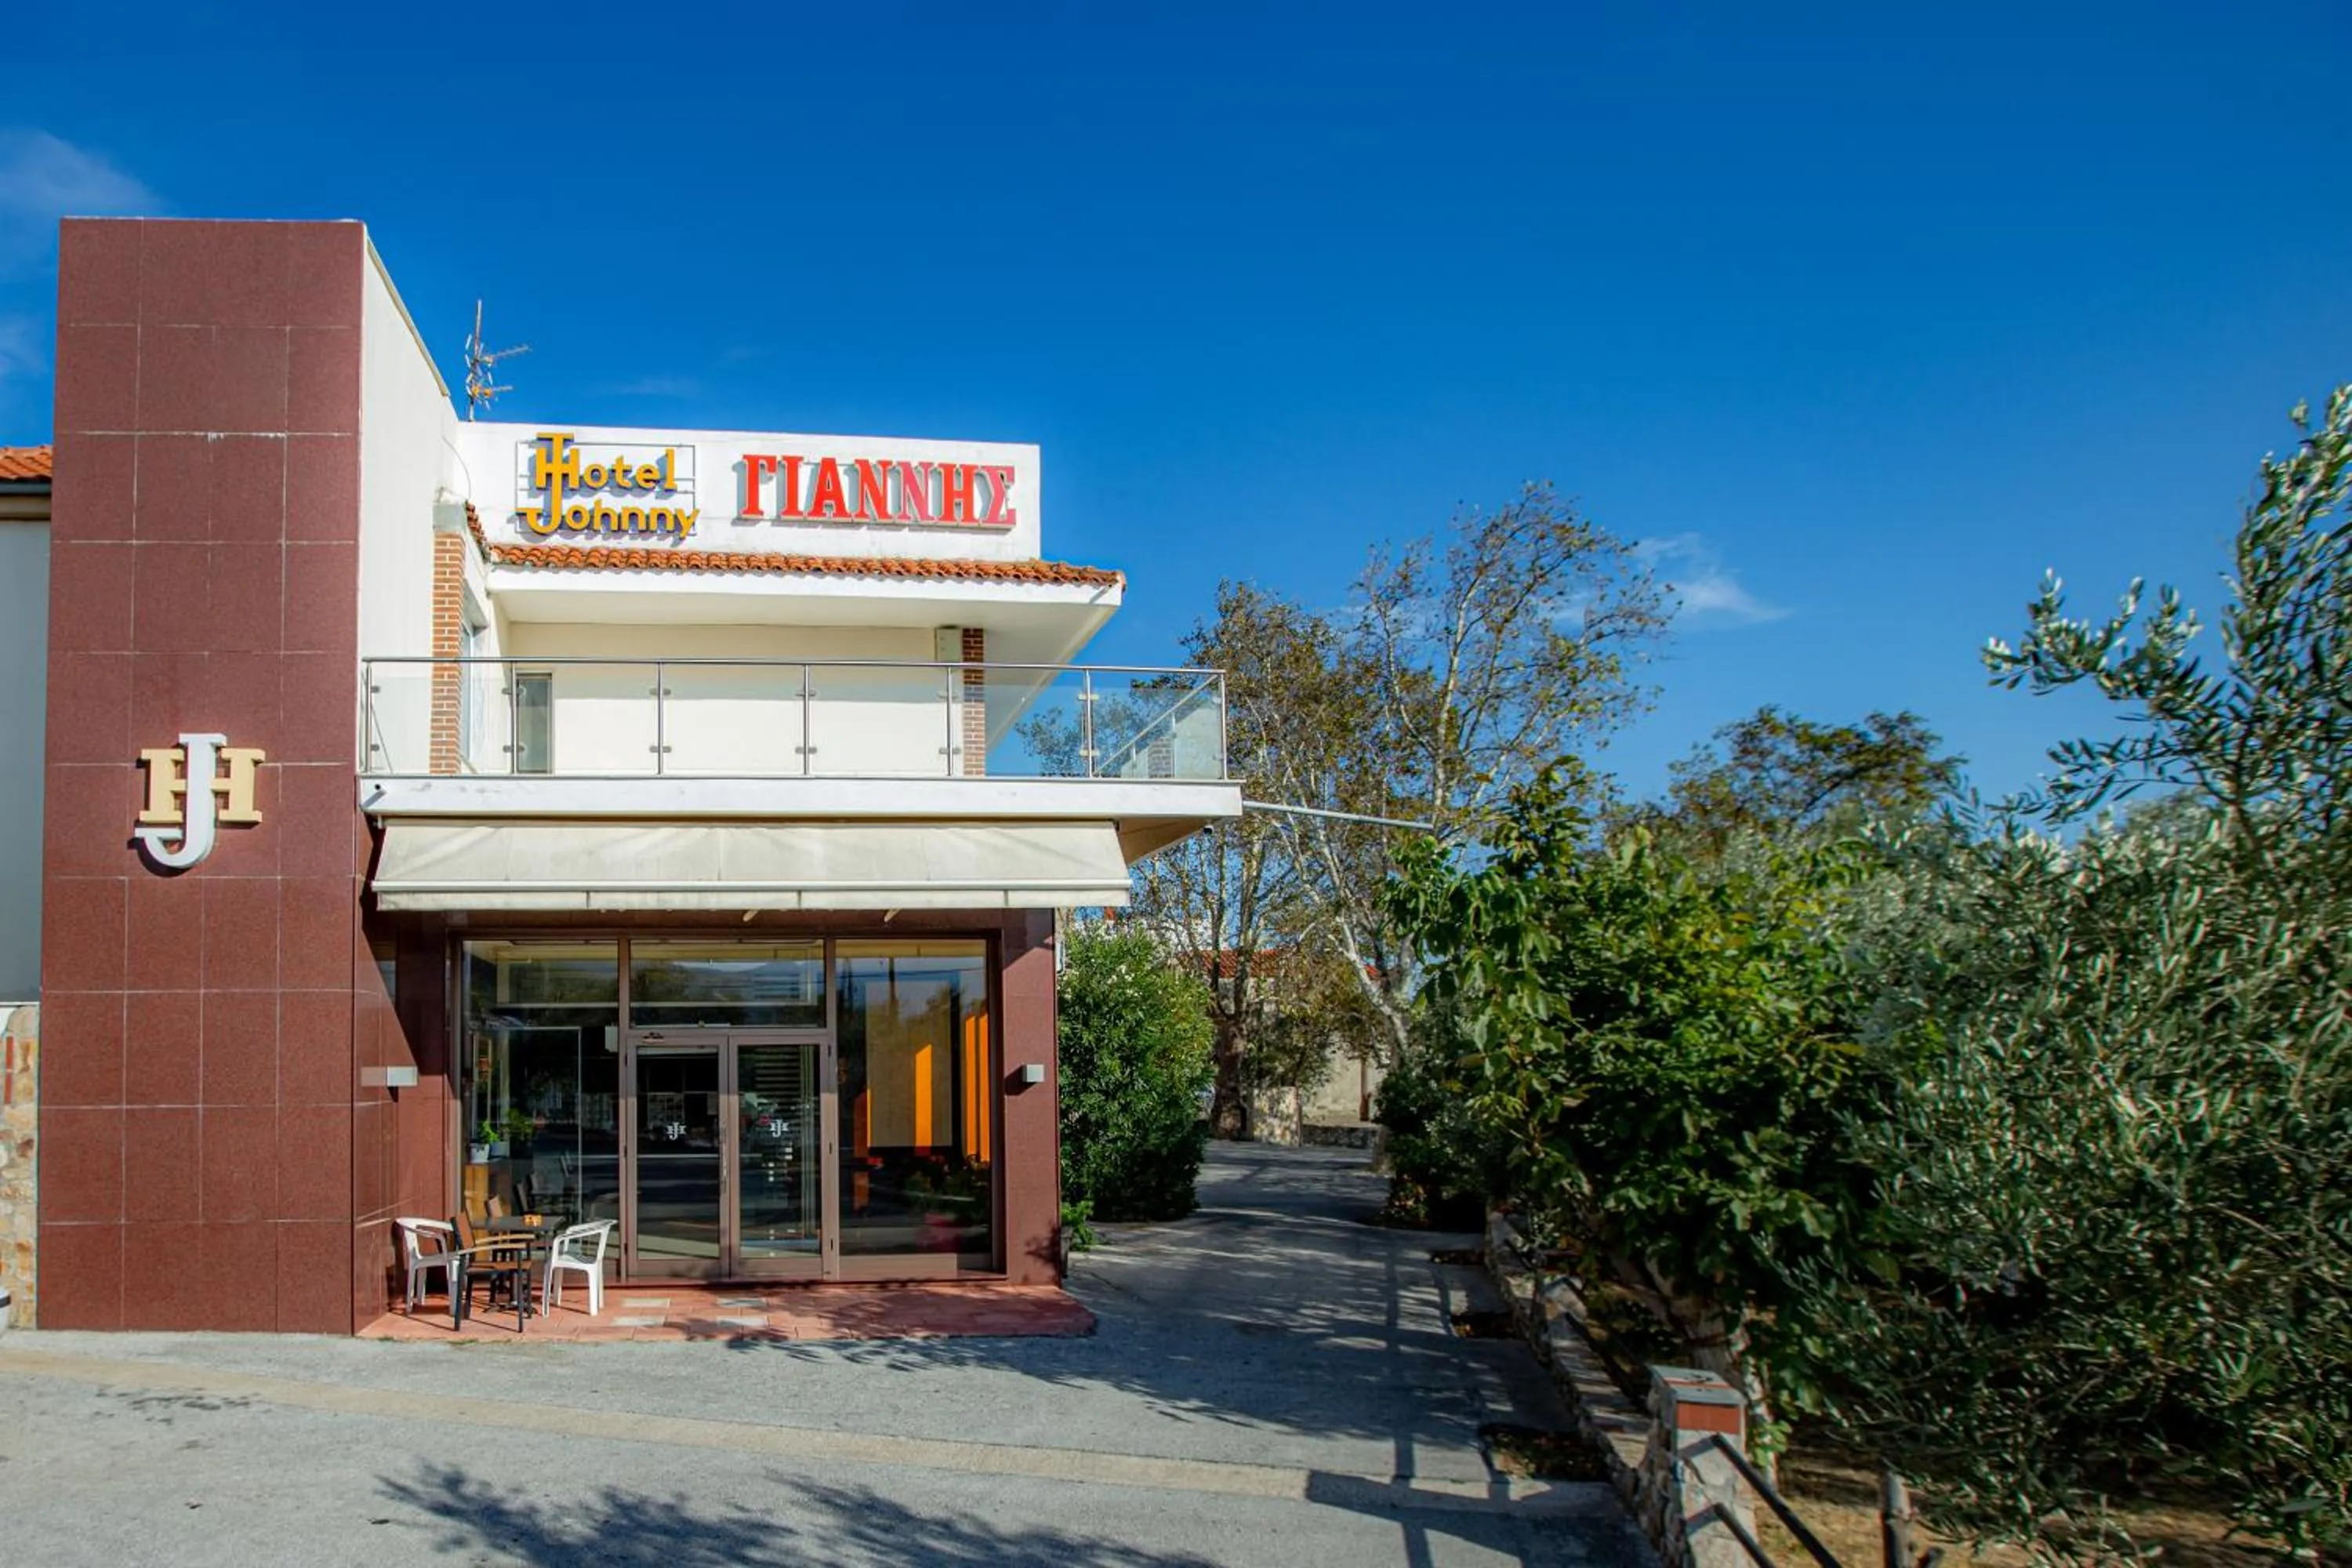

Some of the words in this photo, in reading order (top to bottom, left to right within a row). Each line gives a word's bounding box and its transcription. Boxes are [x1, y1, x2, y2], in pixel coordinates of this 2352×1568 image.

[515, 433, 700, 539] Johnny
[535, 448, 677, 491] Hotel
[741, 454, 1017, 526] ΓΙΑΝΝΗΣ
